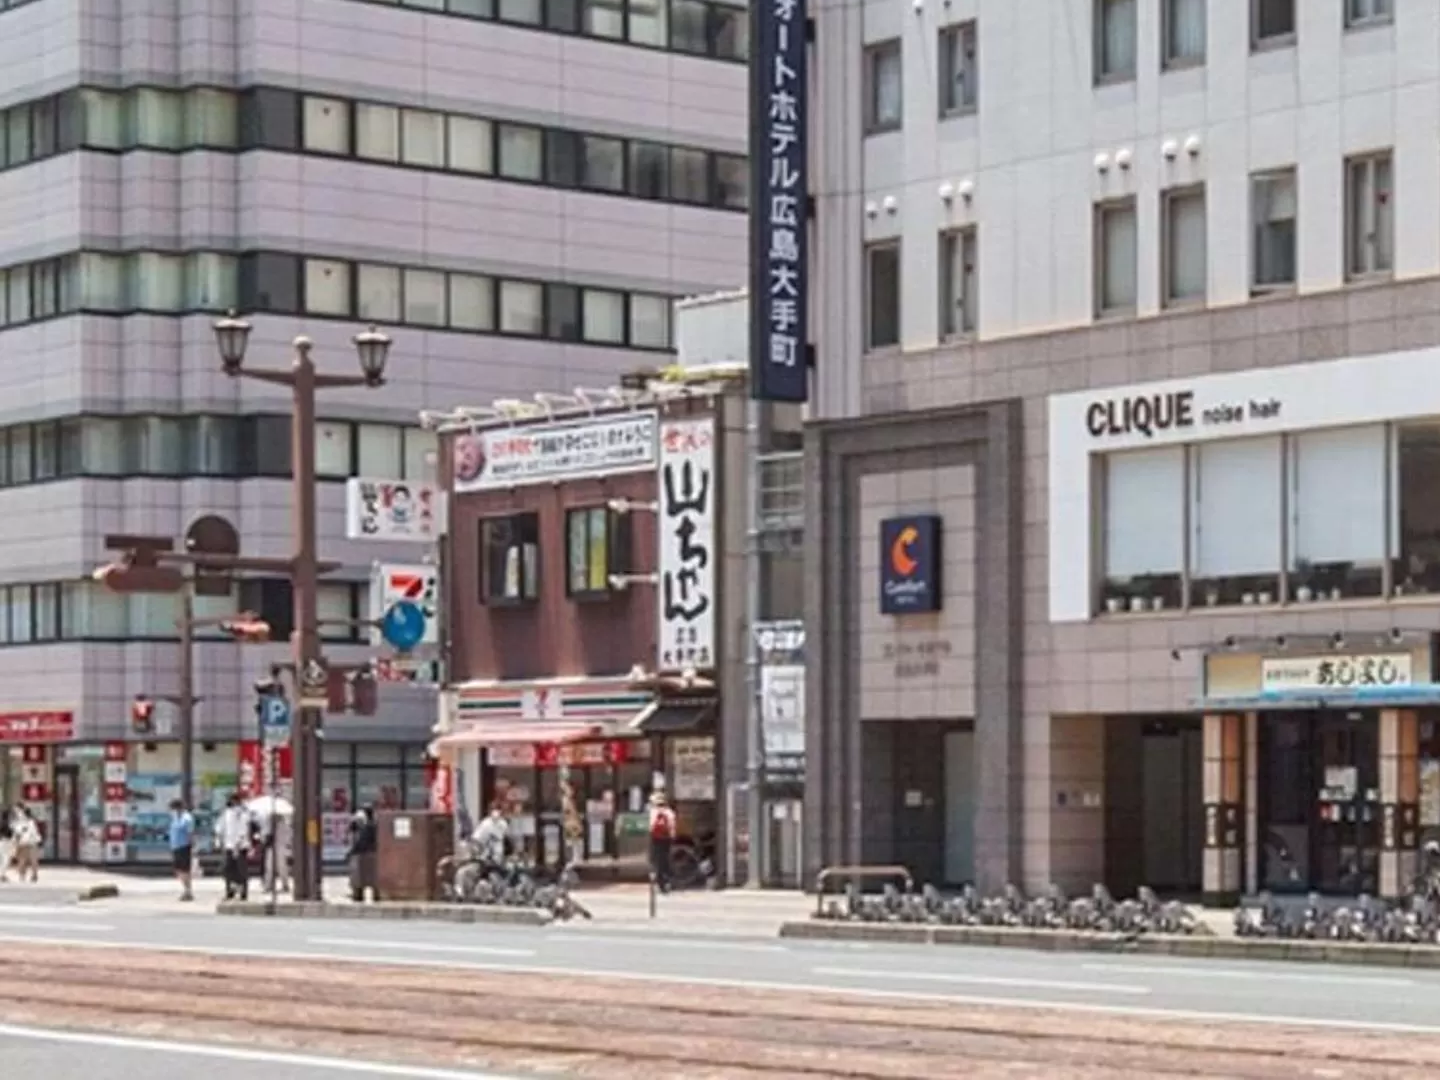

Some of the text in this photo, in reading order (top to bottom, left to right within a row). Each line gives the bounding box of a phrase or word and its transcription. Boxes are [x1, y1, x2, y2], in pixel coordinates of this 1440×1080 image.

[1086, 390, 1282, 437] CLIQUE noise hair
[663, 459, 710, 622] 山ちゃん
[269, 700, 287, 723] P
